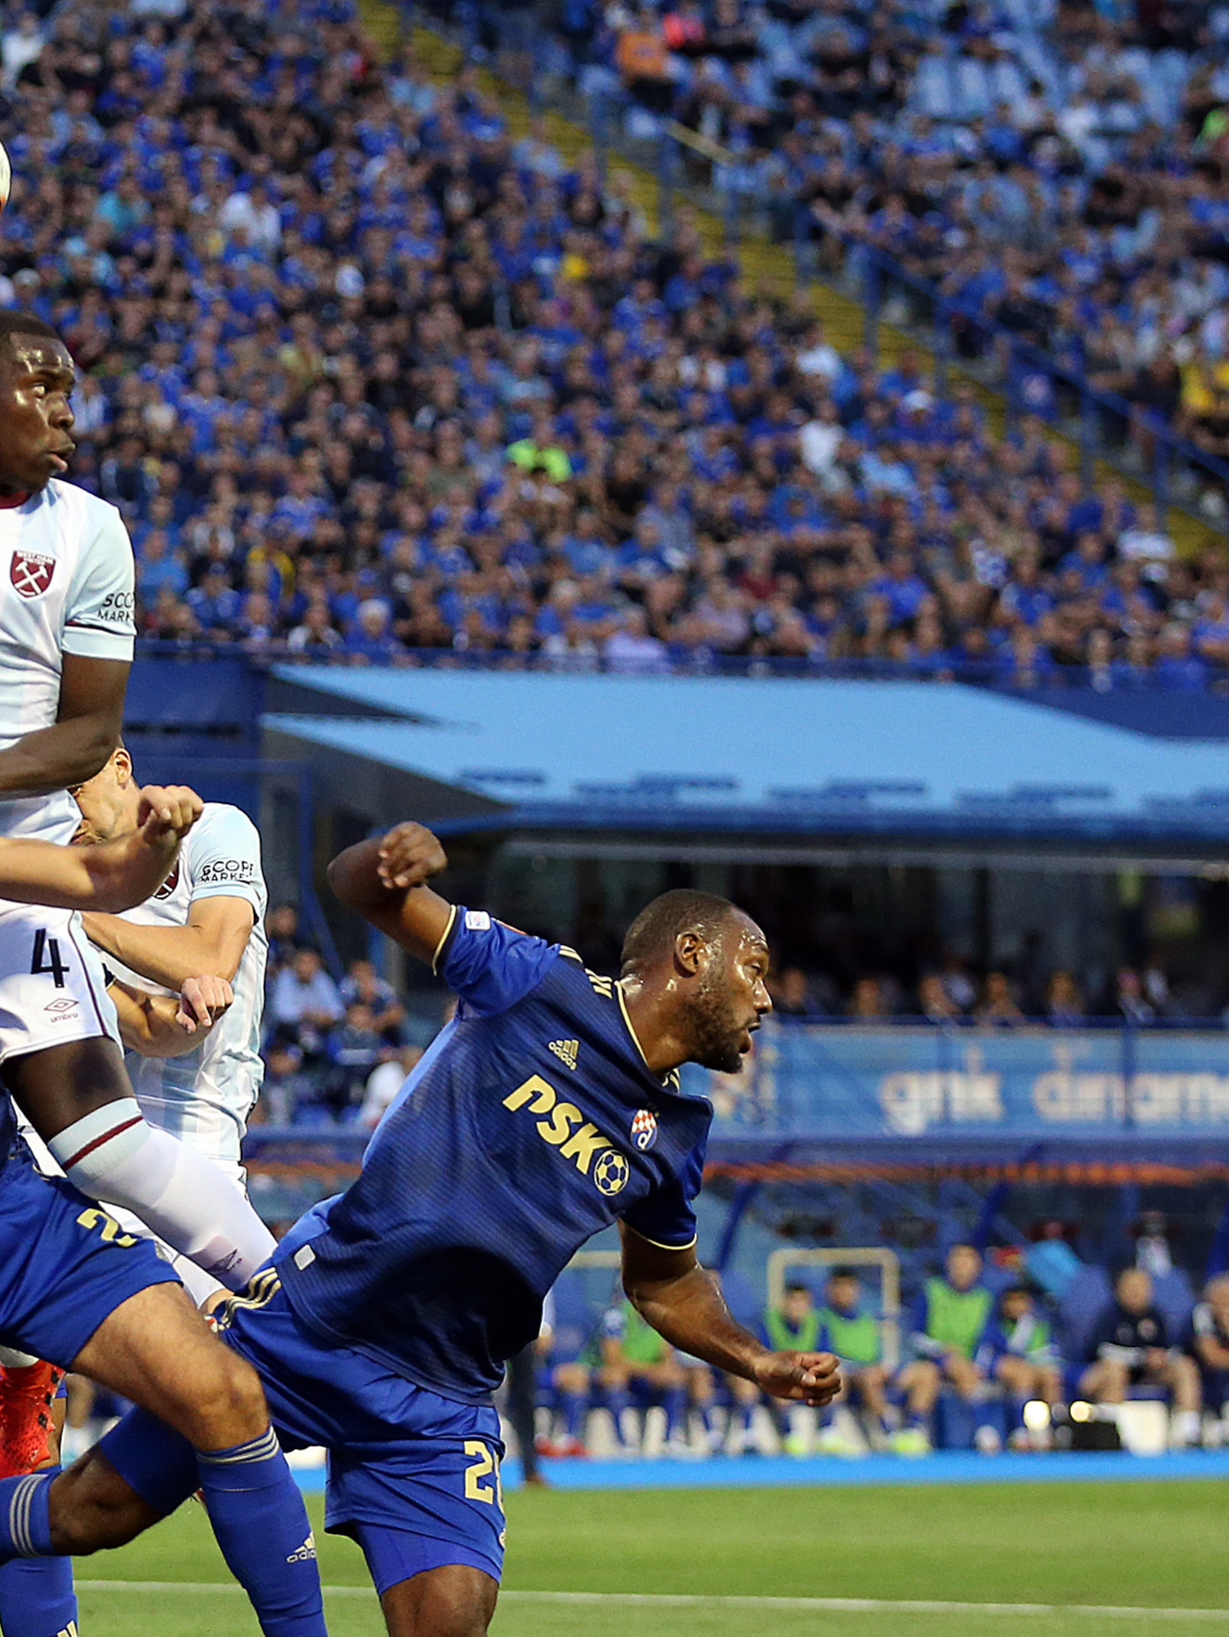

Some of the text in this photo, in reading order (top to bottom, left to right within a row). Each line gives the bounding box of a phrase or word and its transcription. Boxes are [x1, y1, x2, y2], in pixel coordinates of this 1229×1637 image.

[31, 928, 70, 988] 4
[50, 1012, 79, 1023] umbro
[502, 1074, 614, 1174] PSK
[464, 1441, 505, 1515] 2
